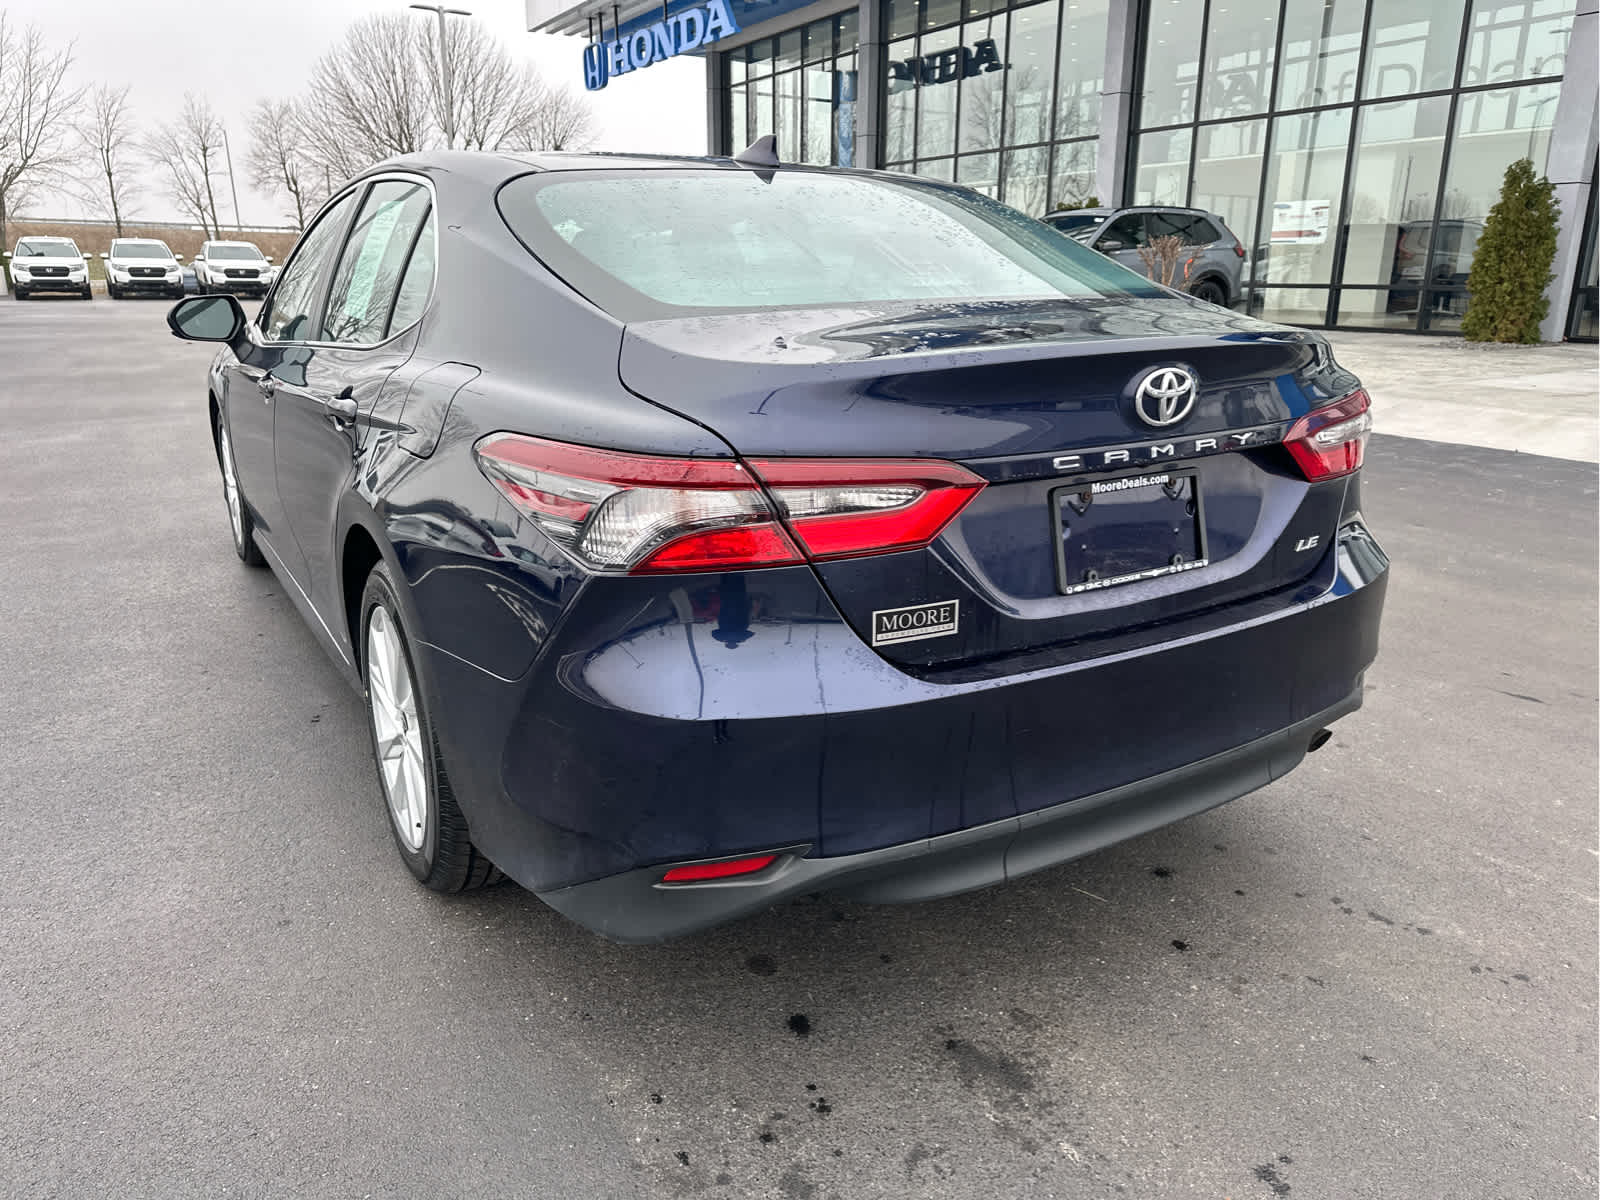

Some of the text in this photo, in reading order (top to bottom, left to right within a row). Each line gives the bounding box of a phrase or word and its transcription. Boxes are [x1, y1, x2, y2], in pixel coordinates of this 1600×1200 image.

[607, 0, 739, 77] HONDA
[1053, 432, 1254, 470] CAMRY
[1091, 474, 1169, 494] MooreDeals.com
[1295, 535, 1320, 552] LE
[881, 607, 951, 632] MOORE
